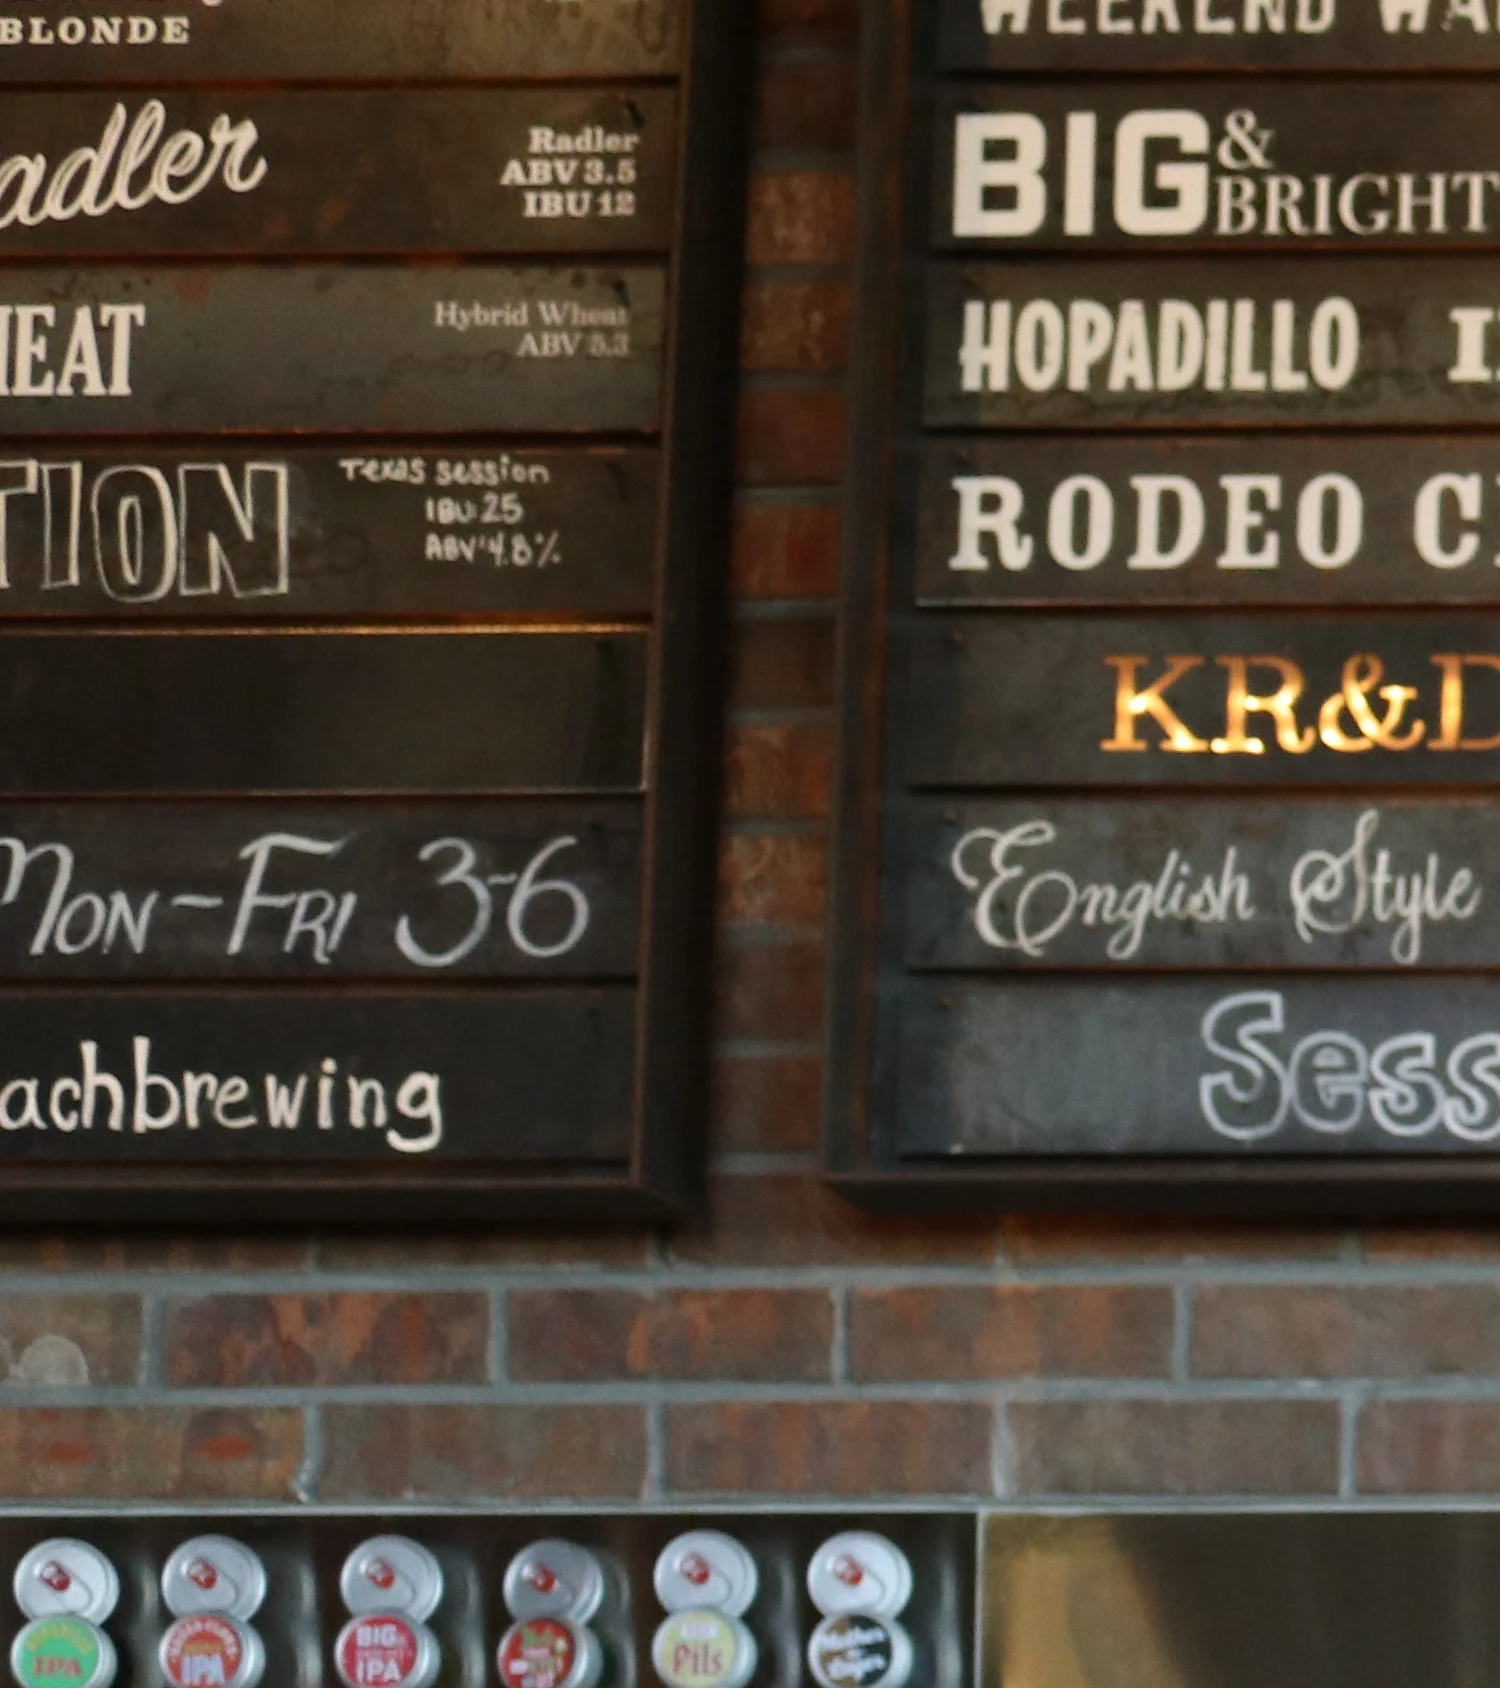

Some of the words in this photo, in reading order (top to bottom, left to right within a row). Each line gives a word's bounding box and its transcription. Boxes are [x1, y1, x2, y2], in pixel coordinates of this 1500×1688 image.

[0, 15, 191, 46] BLONDE
[528, 125, 641, 155] Radler
[499, 157, 581, 187] ABV
[951, 110, 1211, 238] BIG
[1216, 109, 1275, 171] &
[522, 190, 594, 219] IBU
[596, 190, 637, 219] 12
[434, 300, 530, 332] Hybrid
[537, 301, 629, 328] Wheat
[517, 332, 584, 358] ABV
[958, 295, 1362, 393] HOPADILLO
[948, 473, 1364, 571] RODEO
[395, 835, 591, 967] 3-6
[951, 820, 1256, 961] English
[1289, 808, 1484, 965] Style
[355, 1623, 398, 1648] BIG
[33, 1655, 82, 1677] IPA
[180, 1654, 226, 1686] IPA
[355, 1659, 401, 1684] IPA
